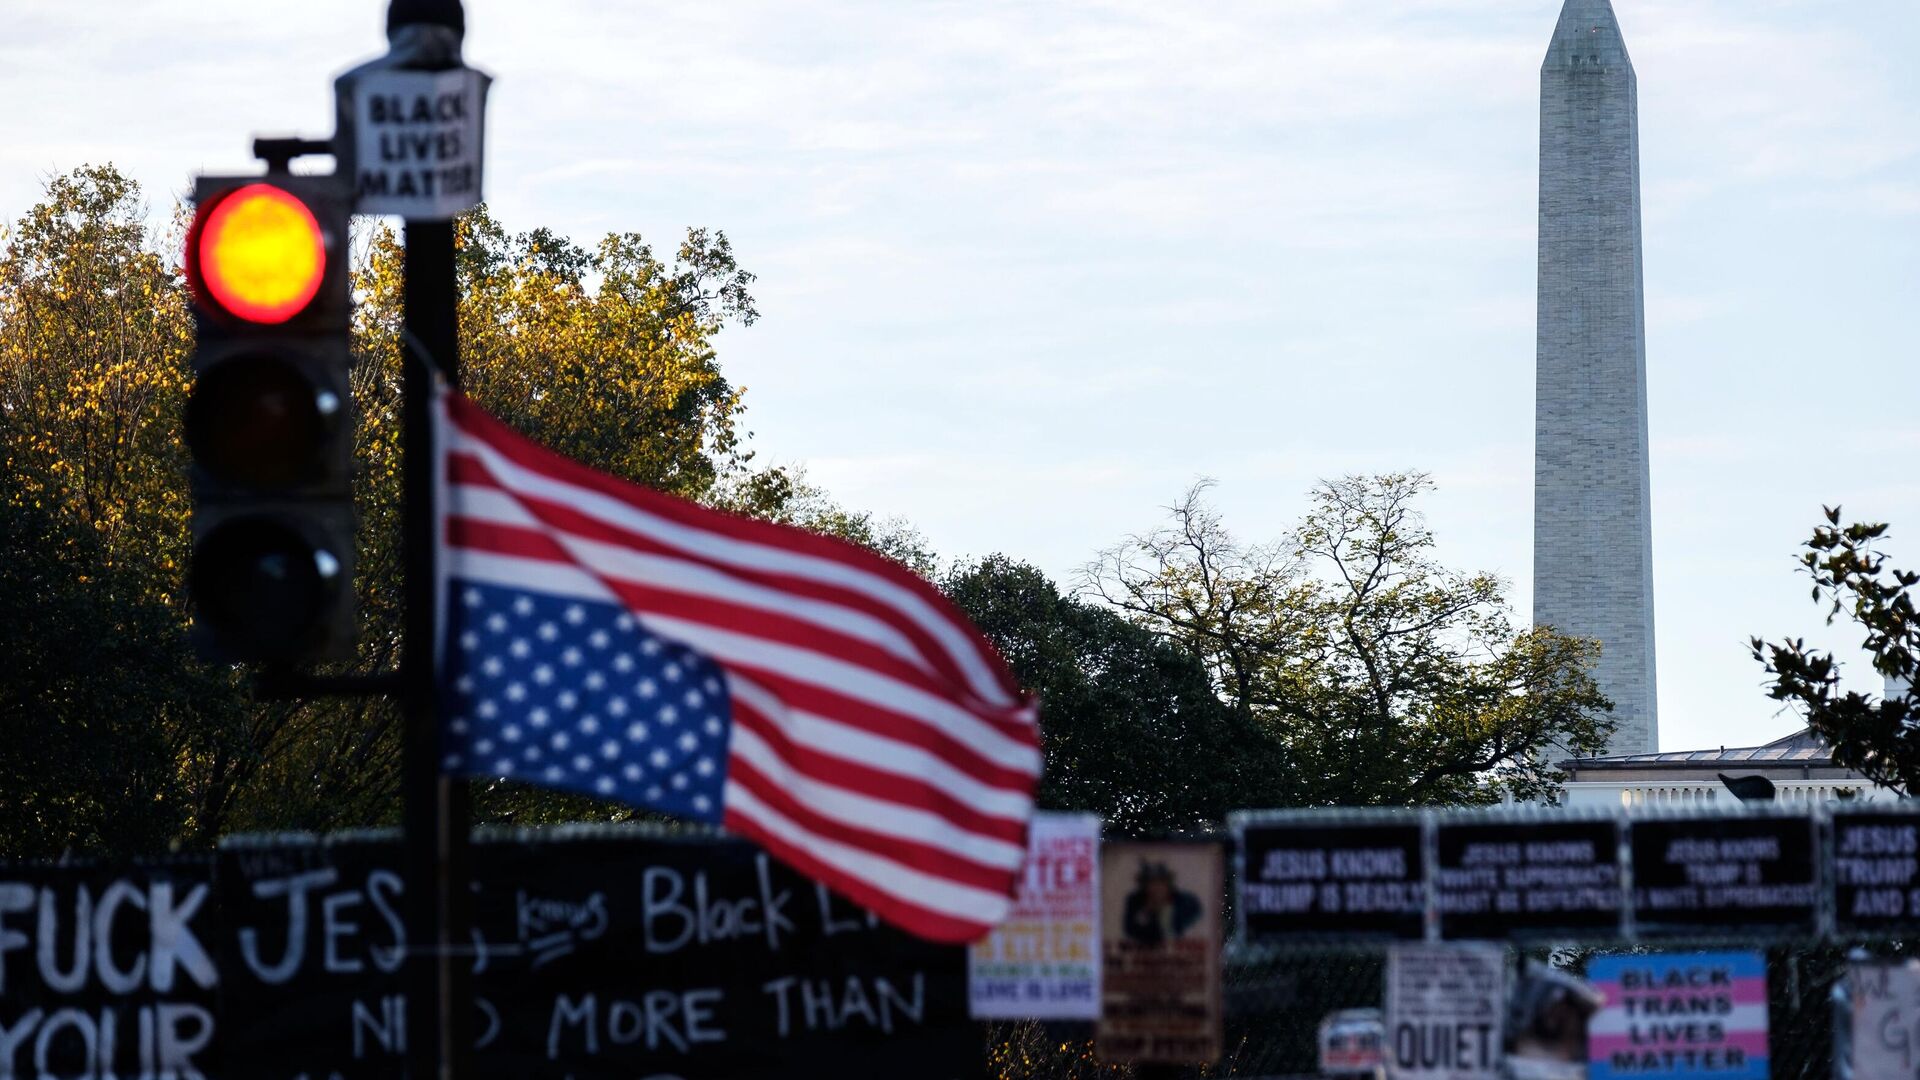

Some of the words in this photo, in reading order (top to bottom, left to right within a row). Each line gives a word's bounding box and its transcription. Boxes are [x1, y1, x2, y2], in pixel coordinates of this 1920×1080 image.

[380, 131, 460, 162] LIVES
[1843, 825, 1917, 852] JESUS
[1261, 849, 1326, 879] JESUS
[1331, 847, 1406, 877] KNOWS
[1837, 858, 1917, 884] TRUMP
[641, 853, 796, 953] Black
[1245, 883, 1315, 912] TRUMP
[1853, 889, 1903, 915] AND
[0, 880, 220, 993] FUCK
[1621, 968, 1731, 990] BLACK
[546, 990, 727, 1059] MORE
[761, 971, 926, 1036] THAN
[1622, 995, 1731, 1017] TRANS
[0, 1003, 215, 1080] YOUR
[1397, 1023, 1491, 1069] QUIET
[1629, 1022, 1723, 1045] LIVES
[1610, 1050, 1744, 1073] MATTER
